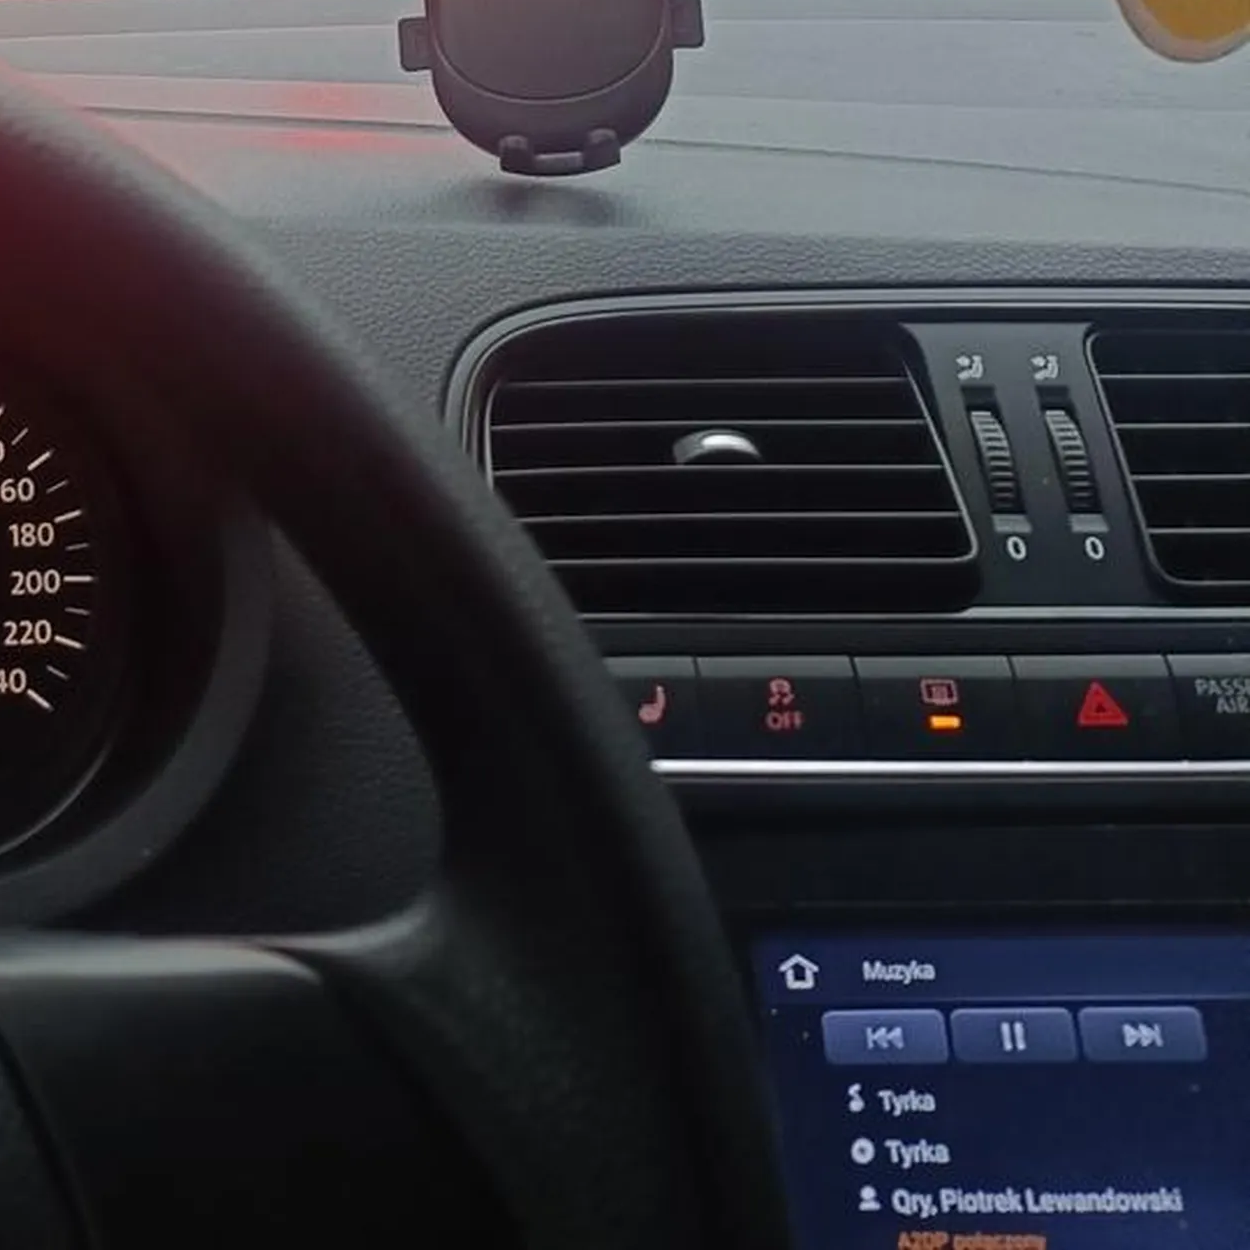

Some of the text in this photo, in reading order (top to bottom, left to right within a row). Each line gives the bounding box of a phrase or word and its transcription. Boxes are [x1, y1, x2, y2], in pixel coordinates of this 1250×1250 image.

[9, 522, 54, 548] 180
[10, 570, 62, 595] 200
[3, 620, 51, 646] 220
[766, 710, 803, 731] OFF
[863, 961, 936, 984] Muzyka
[879, 1090, 936, 1116] Tyrka
[884, 1140, 951, 1168] Tyrka
[891, 1187, 1184, 1218] Qry, Piotrek Lewandowski
